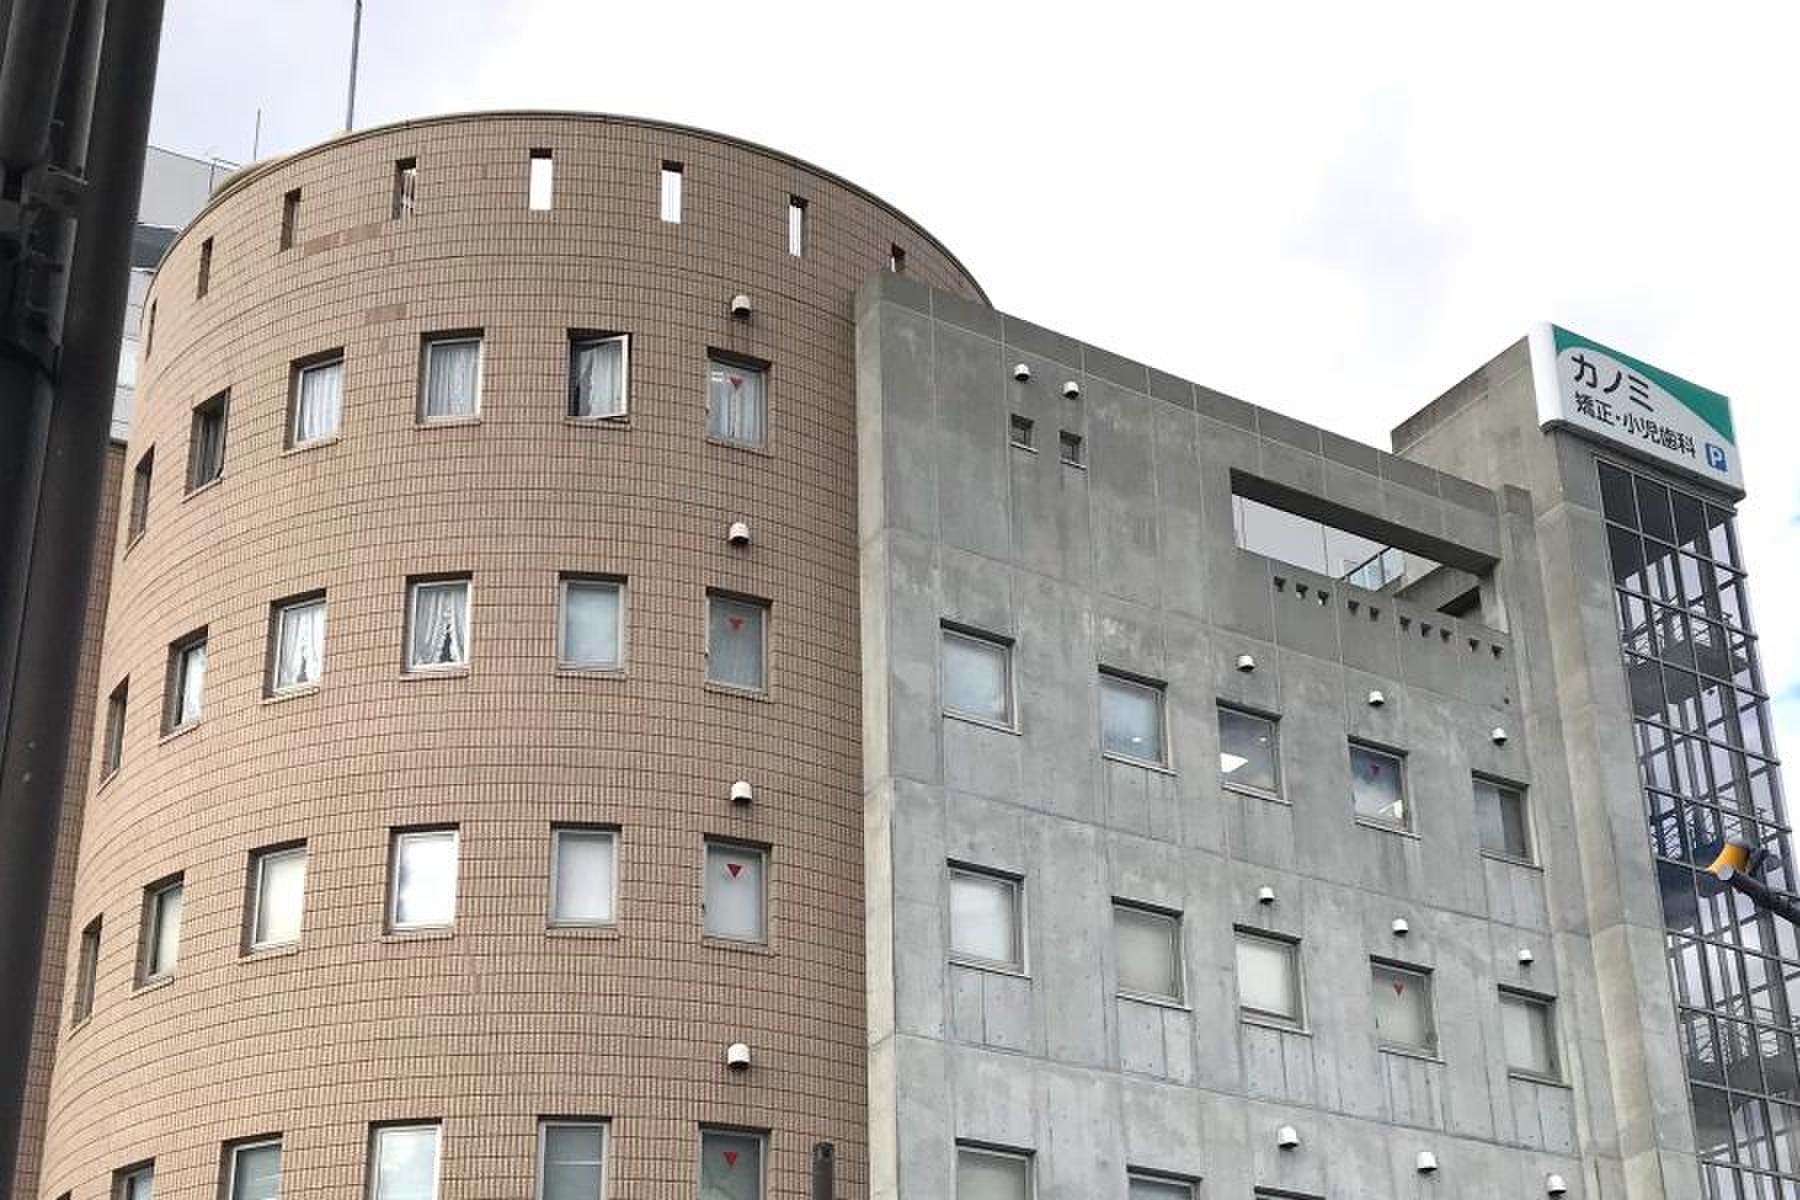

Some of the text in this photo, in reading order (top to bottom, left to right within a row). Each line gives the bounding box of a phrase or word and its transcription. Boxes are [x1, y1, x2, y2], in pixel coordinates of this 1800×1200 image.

[1571, 354, 1654, 412] カノミ
[1710, 446, 1724, 467] P
